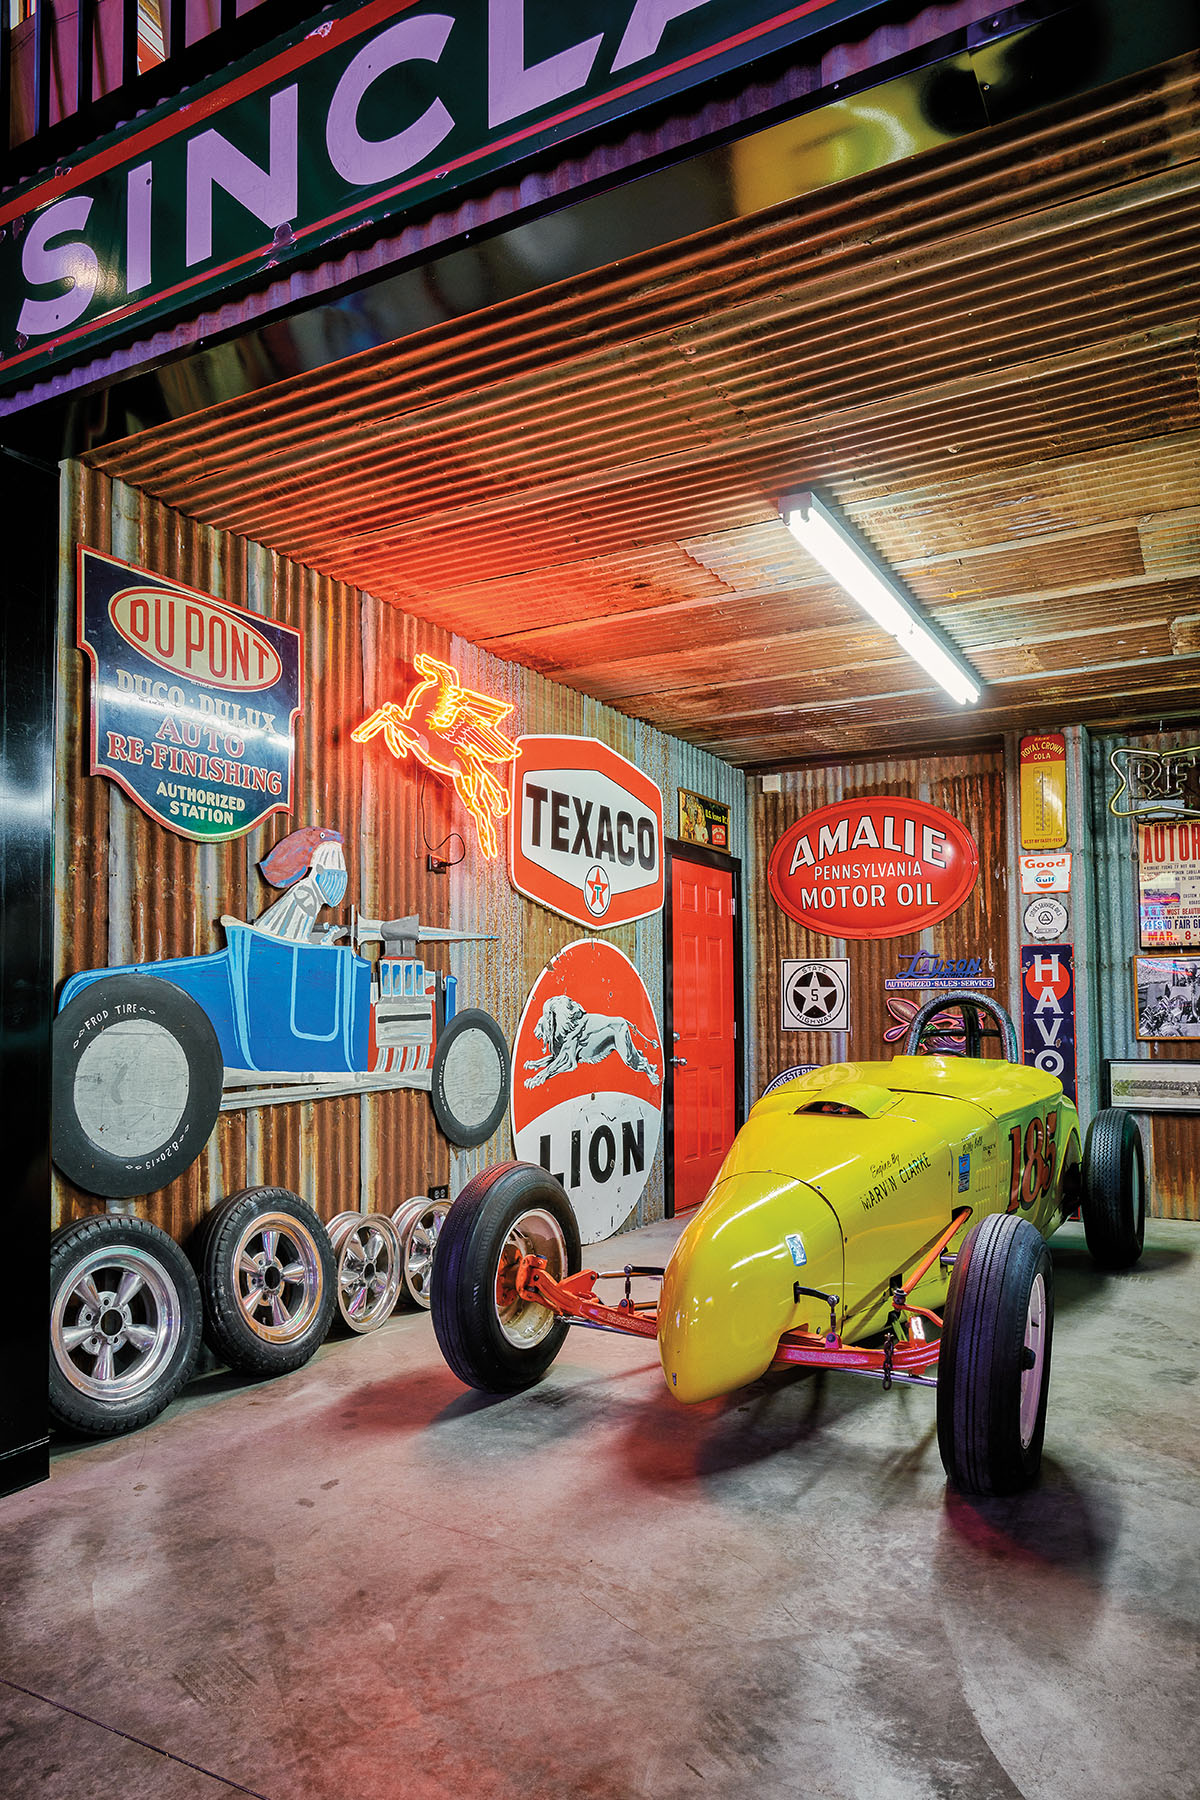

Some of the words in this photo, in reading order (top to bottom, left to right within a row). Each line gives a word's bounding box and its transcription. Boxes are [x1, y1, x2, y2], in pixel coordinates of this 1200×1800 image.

[130, 599, 175, 658] DU
[185, 604, 270, 682] PONT
[115, 669, 185, 708] DUCO
[198, 694, 277, 734] DULUX
[155, 714, 245, 758] AUTO
[1020, 743, 1040, 758] ROYAL
[1041, 741, 1065, 755] CROWN
[107, 731, 282, 796] RE-FINISHING
[1033, 752, 1051, 760] COLA
[156, 781, 246, 812] AUTHORIZED
[169, 802, 234, 826] STATION
[525, 782, 655, 871] TEXACO
[788, 815, 947, 876] AMALIE
[1143, 824, 1200, 864] AUTOR
[814, 861, 922, 881] PENNSYLVANIA
[1024, 857, 1066, 869] Good
[800, 884, 886, 911] MOTOR
[896, 883, 939, 906] OIL
[1147, 931, 1177, 941] MAR.
[1175, 919, 1190, 929] FAIR
[802, 965, 828, 974] STATE
[887, 980, 931, 988] AUTHORIZED
[934, 980, 958, 988] SALES
[961, 979, 993, 987] SERVICE
[811, 988, 819, 1002] 5
[84, 1010, 109, 1031] FROD
[114, 1003, 137, 1016] TIRE
[796, 1013, 832, 1024] HIGHWAY
[539, 1118, 645, 1189] LION
[1005, 1110, 1057, 1215] 185
[859, 1175, 898, 1212] MARVIN
[898, 1152, 932, 1184] CLARKE
